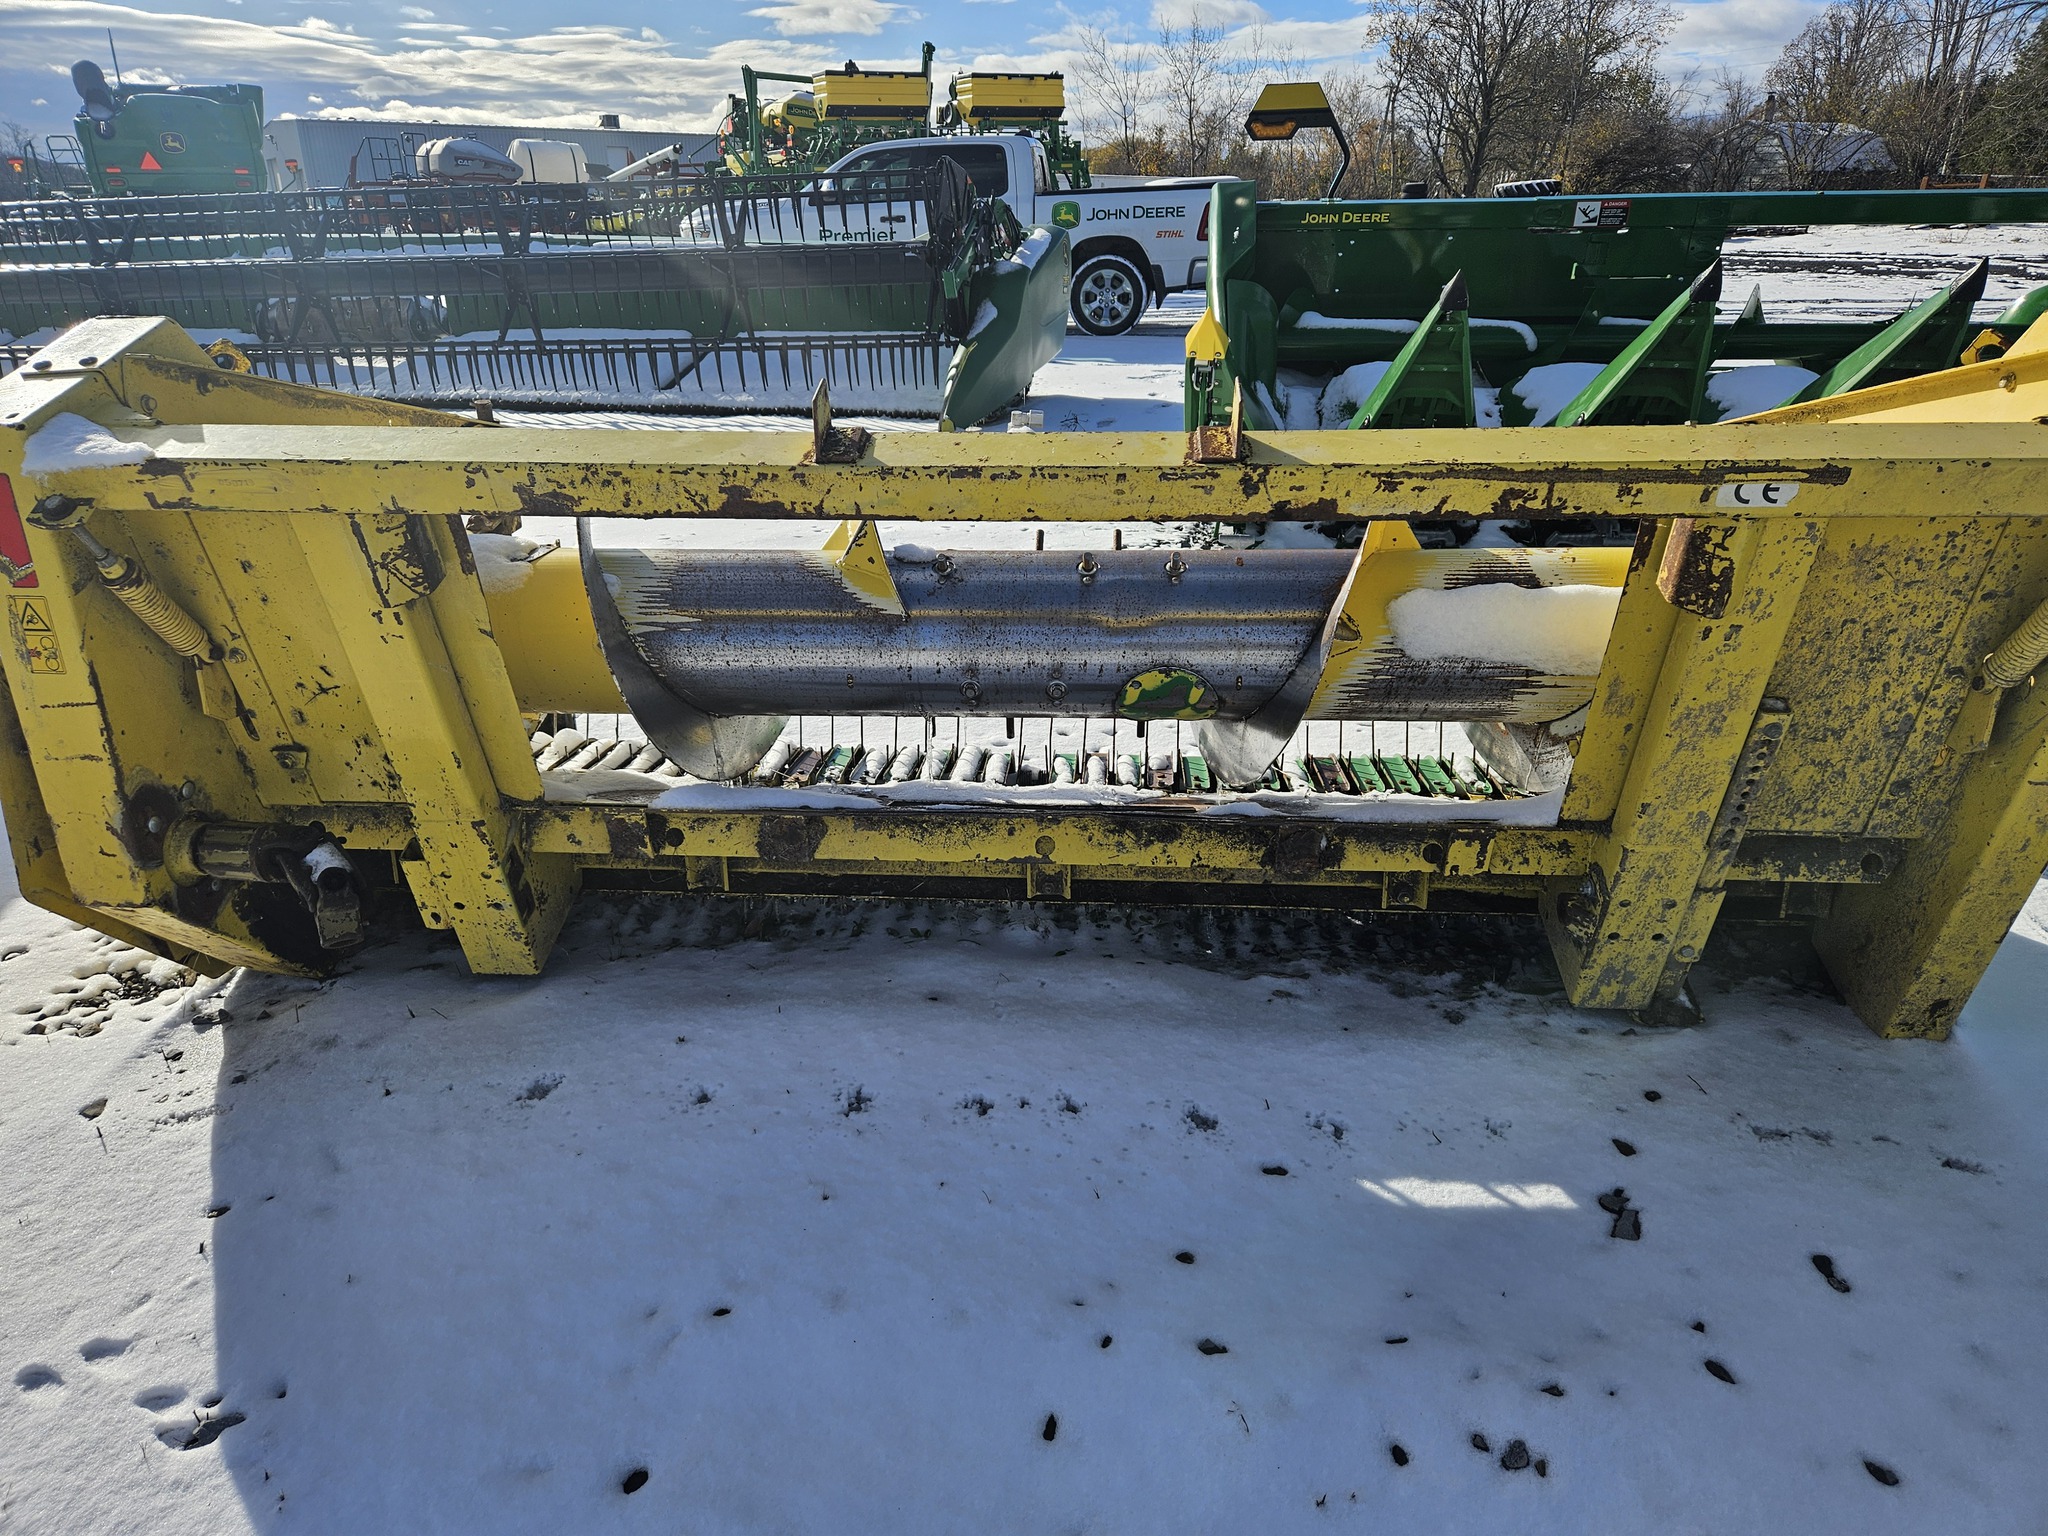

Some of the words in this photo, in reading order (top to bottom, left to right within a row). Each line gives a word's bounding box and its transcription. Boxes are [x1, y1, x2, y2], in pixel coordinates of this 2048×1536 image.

[791, 107, 808, 115] JOHN
[1301, 212, 1339, 224] JOHN
[1341, 211, 1390, 223] DEERE
[819, 228, 897, 242] Premier
[1155, 230, 1184, 239] STIHL
